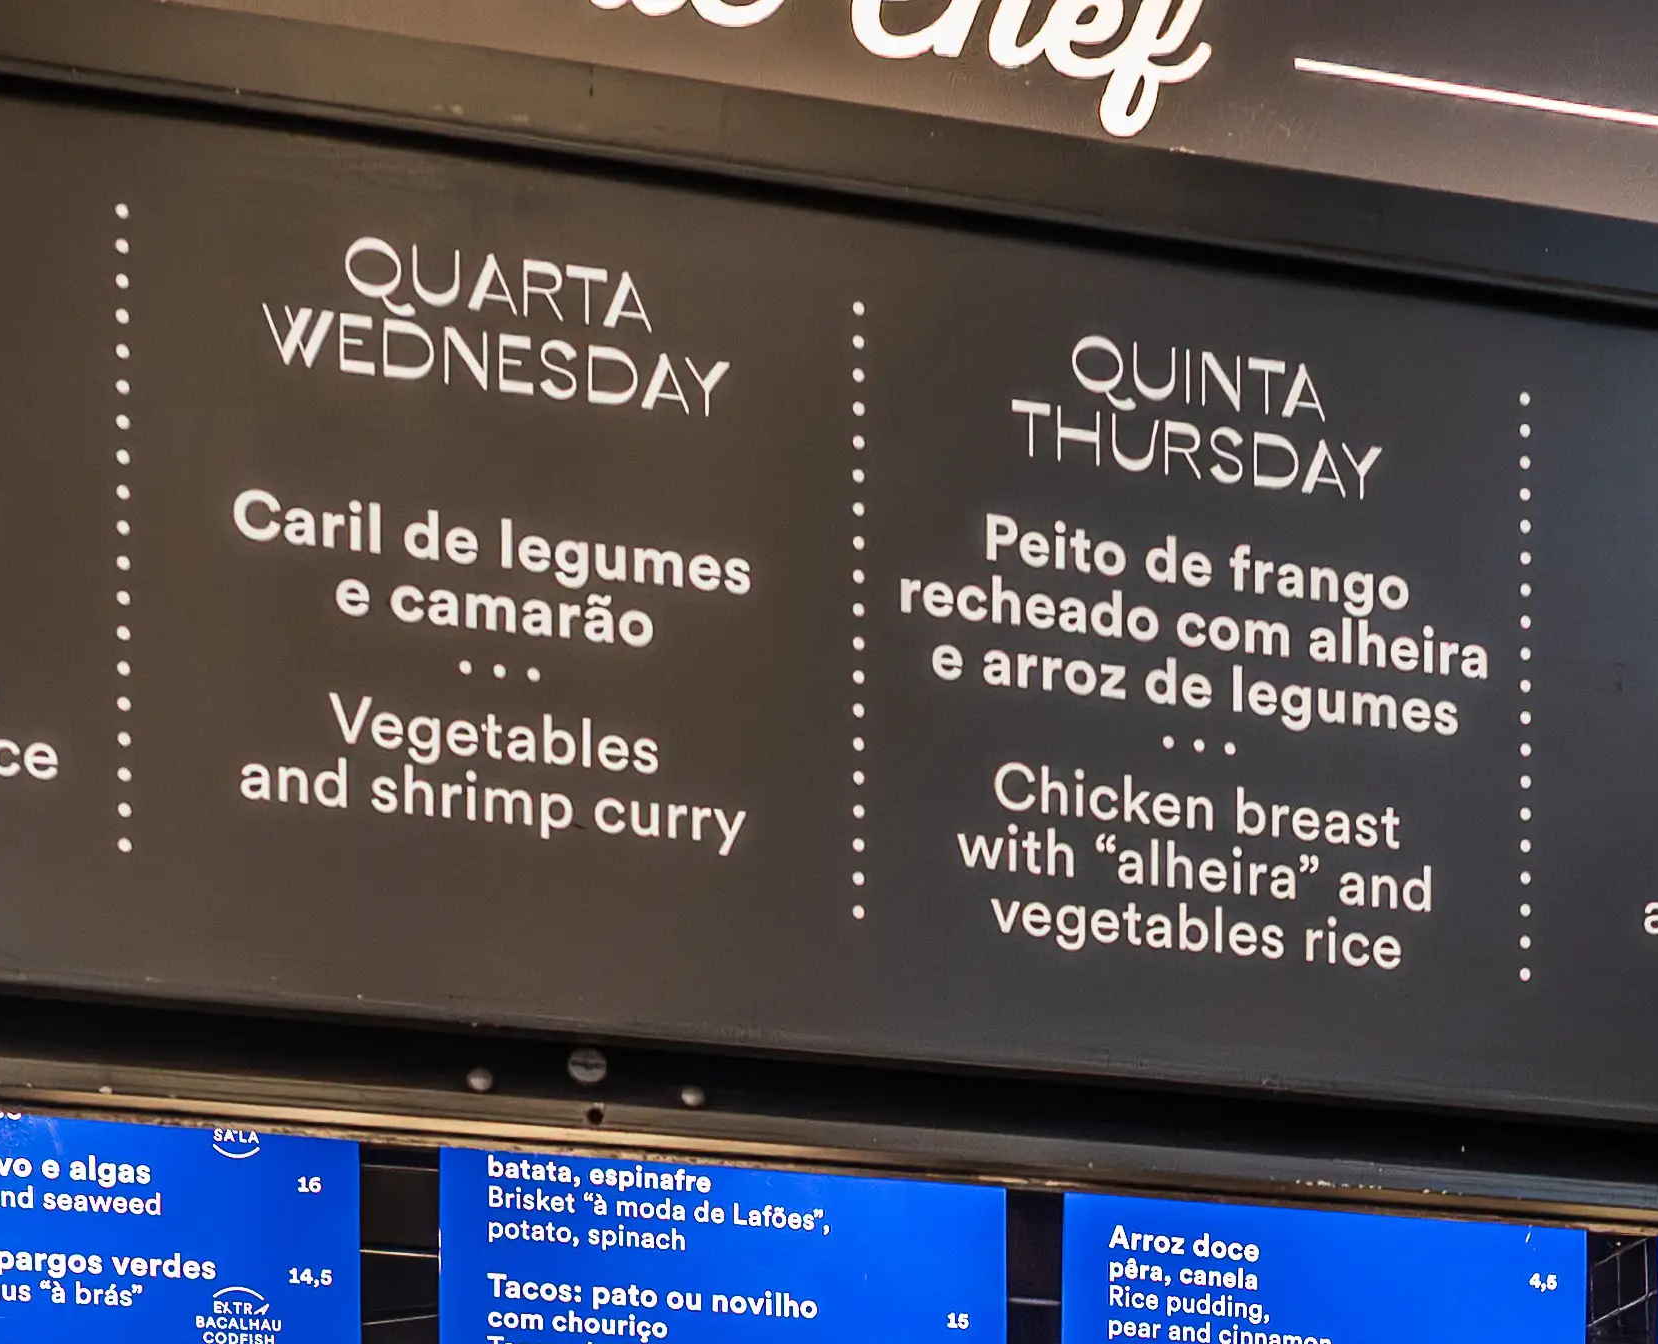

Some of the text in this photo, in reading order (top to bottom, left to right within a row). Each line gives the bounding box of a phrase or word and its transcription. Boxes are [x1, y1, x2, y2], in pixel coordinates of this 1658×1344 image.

[340, 237, 651, 332] QUARTA
[262, 302, 729, 416] WEDNESDAY
[1072, 336, 1325, 422] QUINTA
[1012, 399, 1382, 500] THURSDAY
[234, 490, 750, 594] Caril de legumes
[336, 579, 653, 647] e camarão
[329, 692, 658, 774] Vegetables
[241, 757, 746, 856] and shrimp curry
[43, 1186, 161, 1215] seaweed
[298, 1177, 321, 1193] 16
[1109, 1225, 1259, 1262] Arroz doce
[289, 1268, 332, 1288] 14,5
[487, 1273, 817, 1318] Tacos: pato ou novilho
[1529, 1273, 1557, 1292] 4,5
[196, 1316, 281, 1331] BACALHAU
[488, 1310, 667, 1343] com chouriço
[947, 1313, 969, 1329] 15
